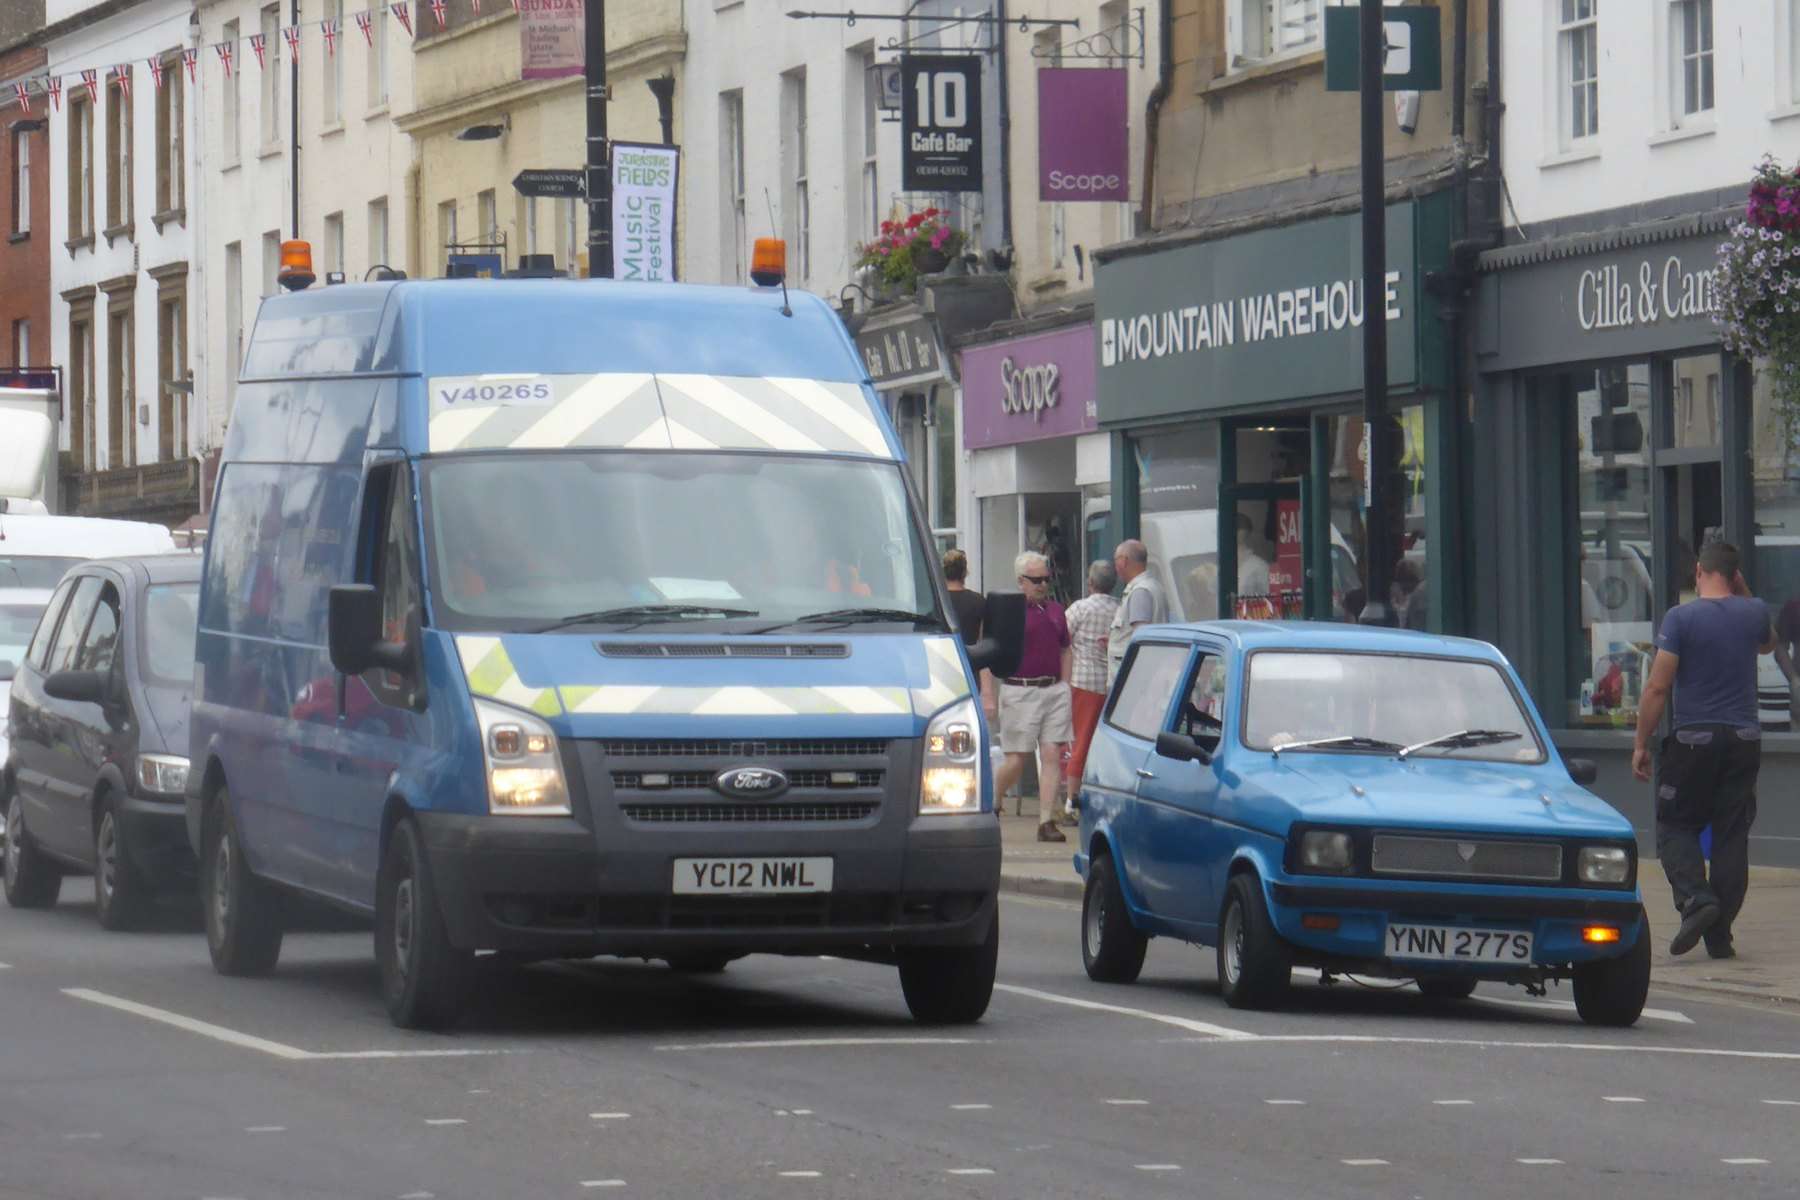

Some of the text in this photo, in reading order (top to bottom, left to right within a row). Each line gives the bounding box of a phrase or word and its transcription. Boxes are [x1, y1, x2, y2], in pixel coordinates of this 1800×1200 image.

[914, 71, 967, 127] 10
[911, 132, 972, 152] Café Bar
[1049, 171, 1120, 191] Scope
[621, 196, 643, 281] Music
[645, 197, 663, 282] Festival
[1118, 271, 1400, 362] MOUNTAIN WAREHOUE
[1578, 263, 1633, 330] Cilla
[1638, 260, 1658, 323] &
[441, 384, 549, 404] V40265
[1001, 357, 1058, 423] Scope
[734, 771, 772, 789] Ford
[692, 862, 814, 887] YC12 NWL
[1390, 926, 1529, 959] YNN 277S
